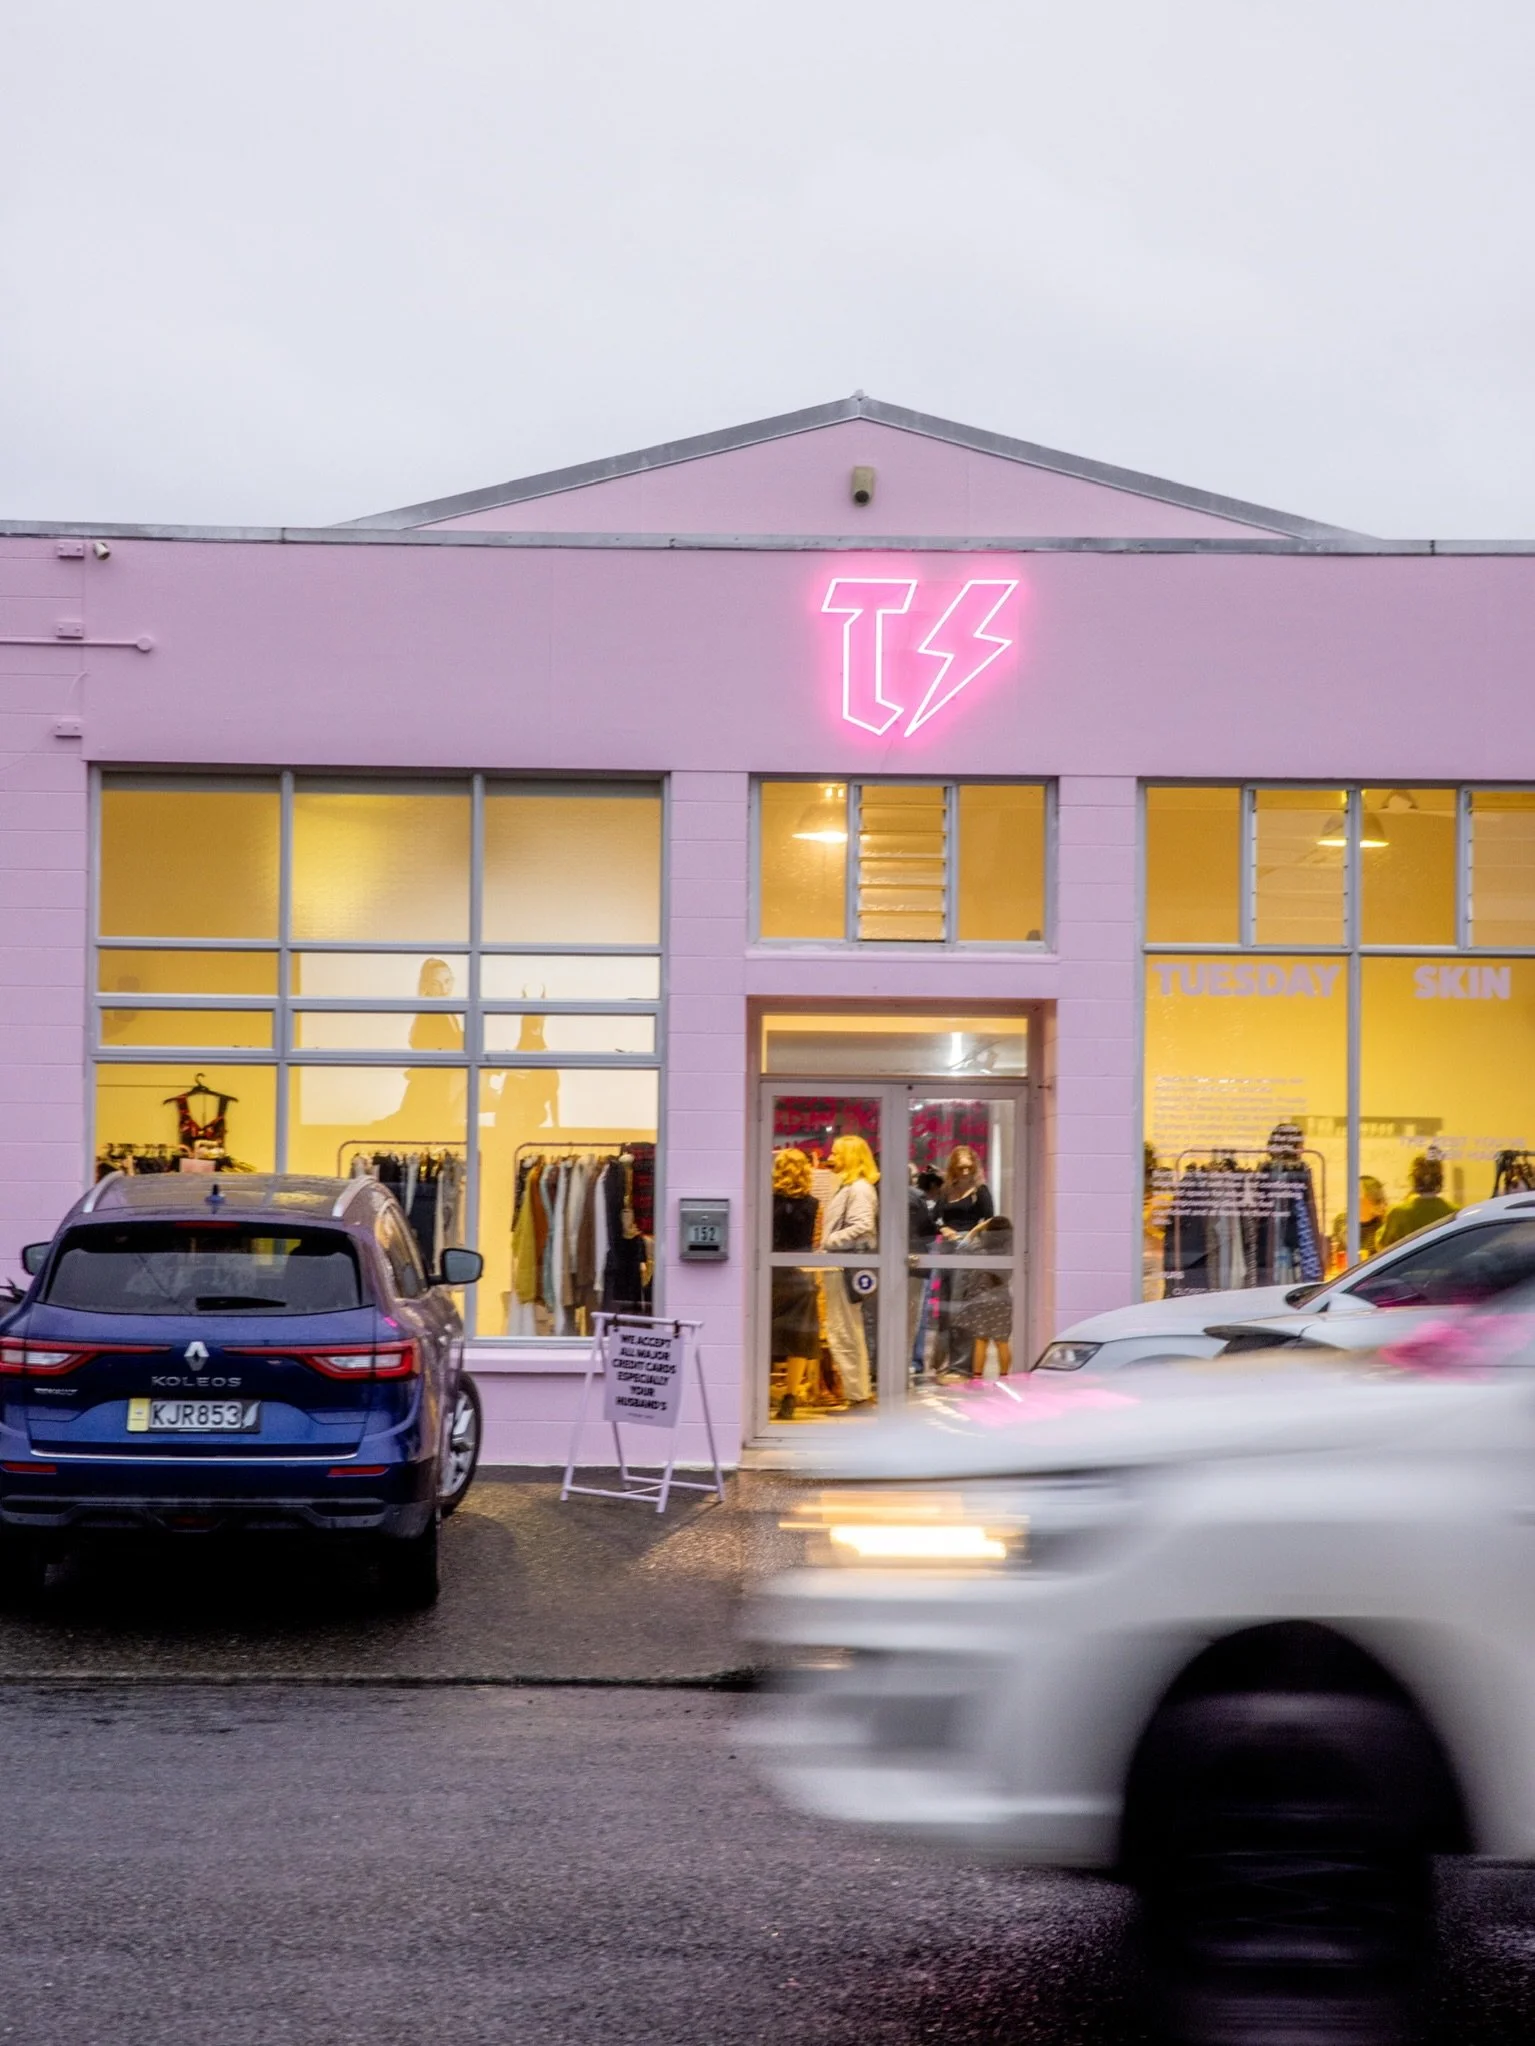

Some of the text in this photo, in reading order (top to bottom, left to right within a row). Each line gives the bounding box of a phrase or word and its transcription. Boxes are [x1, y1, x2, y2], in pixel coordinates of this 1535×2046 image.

[1153, 964, 1512, 1000] TUESDAY SKIN
[694, 1226, 716, 1241] 152
[621, 1334, 672, 1349] WE ACCEPT
[620, 1347, 670, 1361] ALL MAJOR
[612, 1358, 677, 1374] CREDIT CARDS
[151, 1376, 242, 1387] KOLEOS
[617, 1371, 669, 1386] ESPECIALLY
[630, 1385, 655, 1397] YOUR
[151, 1404, 241, 1427] KJR853
